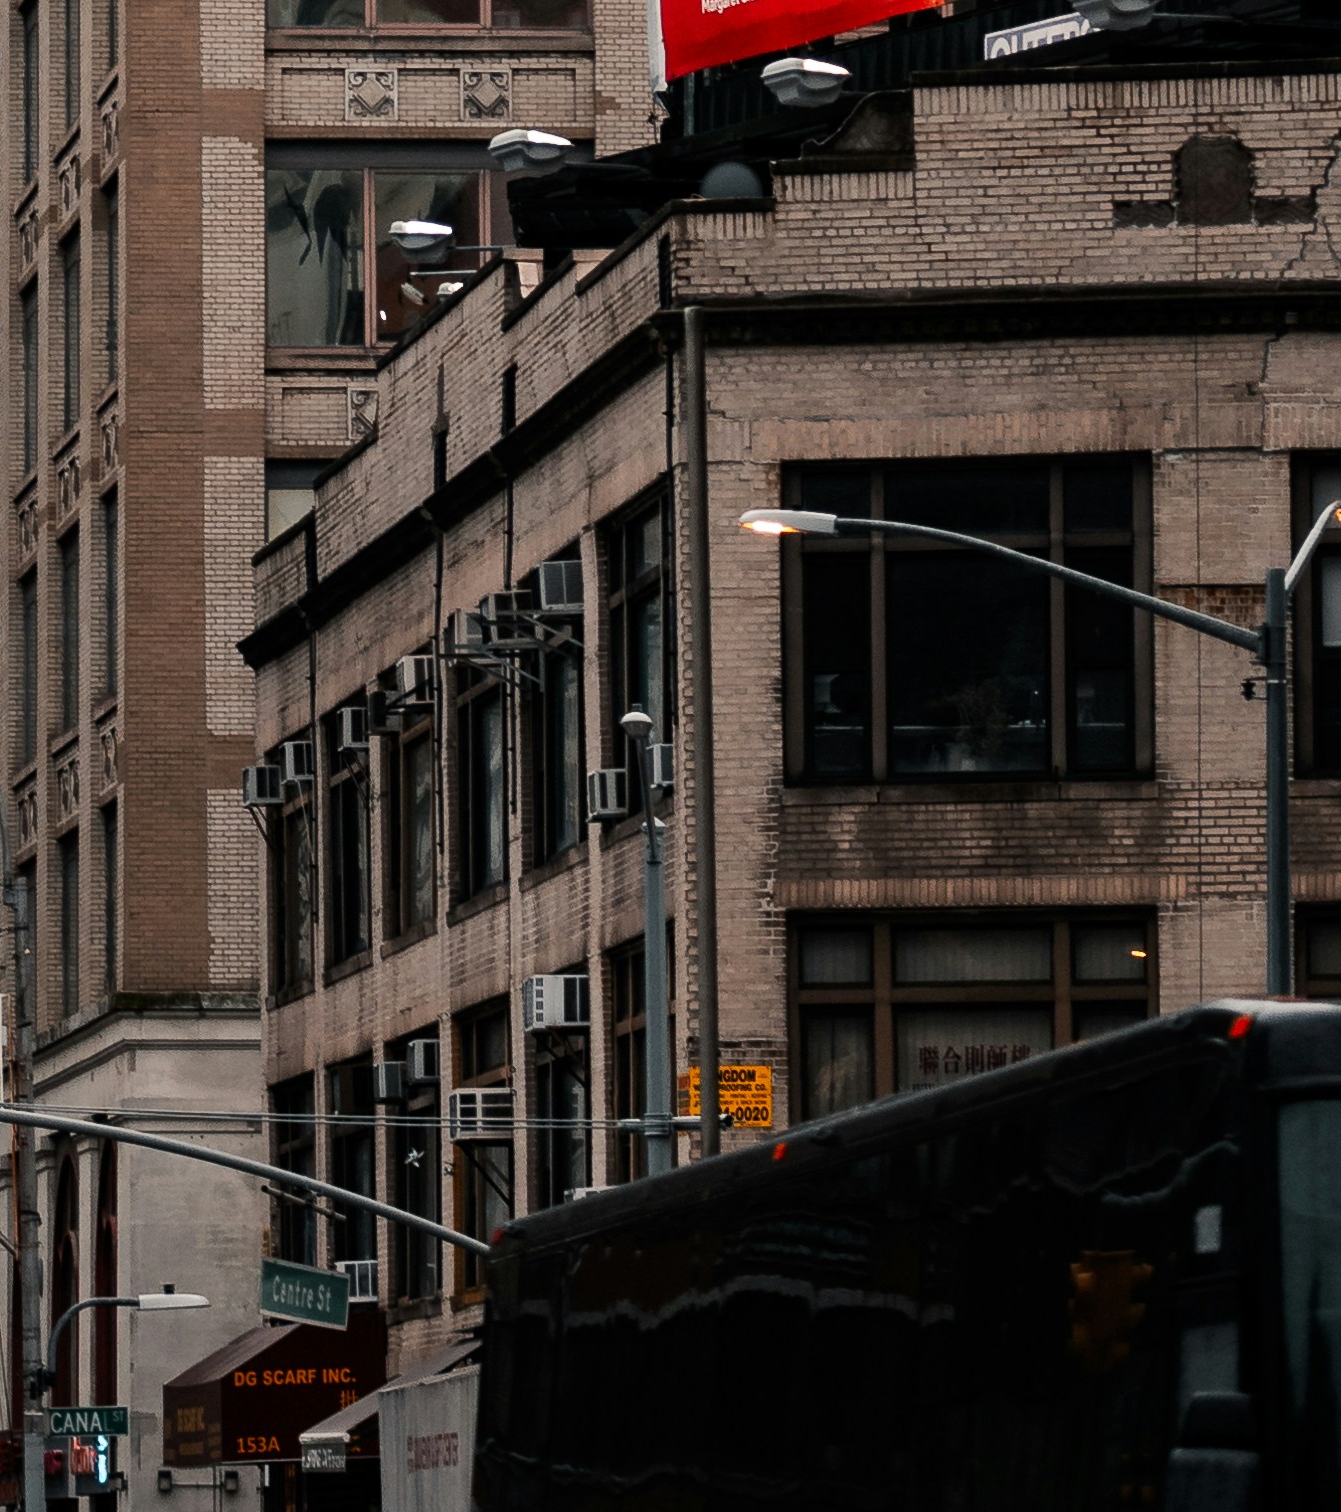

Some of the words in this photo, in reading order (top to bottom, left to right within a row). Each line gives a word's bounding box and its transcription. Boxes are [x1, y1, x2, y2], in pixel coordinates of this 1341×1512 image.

[718, 1069, 756, 1083] NGDOM
[272, 1274, 314, 1311] Centre
[317, 1283, 332, 1314] St
[234, 1371, 258, 1387] DG
[262, 1369, 317, 1386] SCARF
[322, 1367, 357, 1384] INC.
[50, 1412, 115, 1434] CANAL
[112, 1410, 125, 1423] ST
[236, 1436, 281, 1454] 153A
